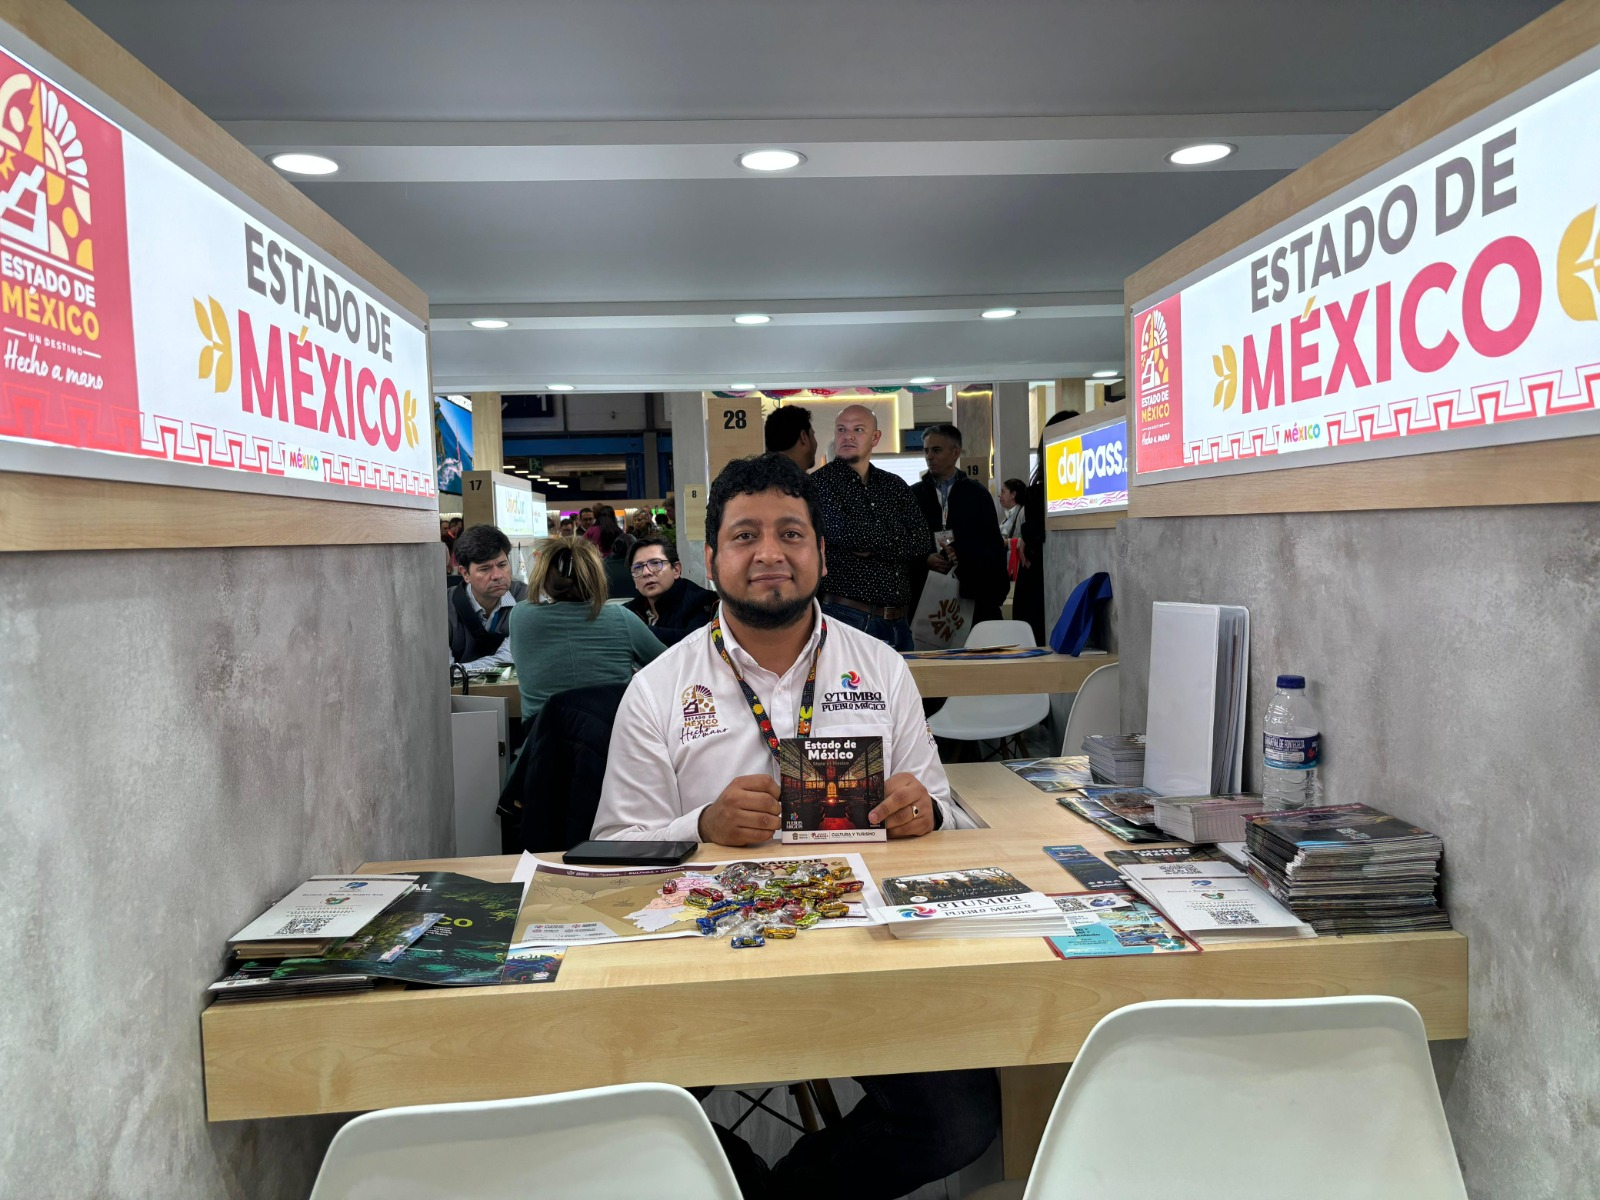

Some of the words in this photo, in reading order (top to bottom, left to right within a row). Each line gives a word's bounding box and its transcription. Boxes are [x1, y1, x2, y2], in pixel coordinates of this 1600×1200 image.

[1251, 185, 1418, 313] ESTADO
[1435, 127, 1517, 236] DE
[1, 251, 72, 298] ESTADO
[74, 279, 96, 307] DE
[245, 222, 361, 343] ESTADO
[366, 302, 392, 363] DE
[2, 281, 100, 341] MÉXICO
[1242, 236, 1542, 414] MÉXICO
[28, 333, 42, 345] UN
[43, 337, 84, 356] DESTINO
[4, 339, 49, 376] Hecho
[52, 365, 64, 381] a
[66, 368, 104, 390] mano
[238, 309, 402, 452] MÉXICO
[723, 409, 747, 430] 28
[470, 480, 482, 490] 17
[967, 465, 979, 476] 19
[691, 490, 698, 499] 8
[804, 740, 841, 750] Estado
[844, 739, 857, 749] de
[808, 749, 855, 761] México
